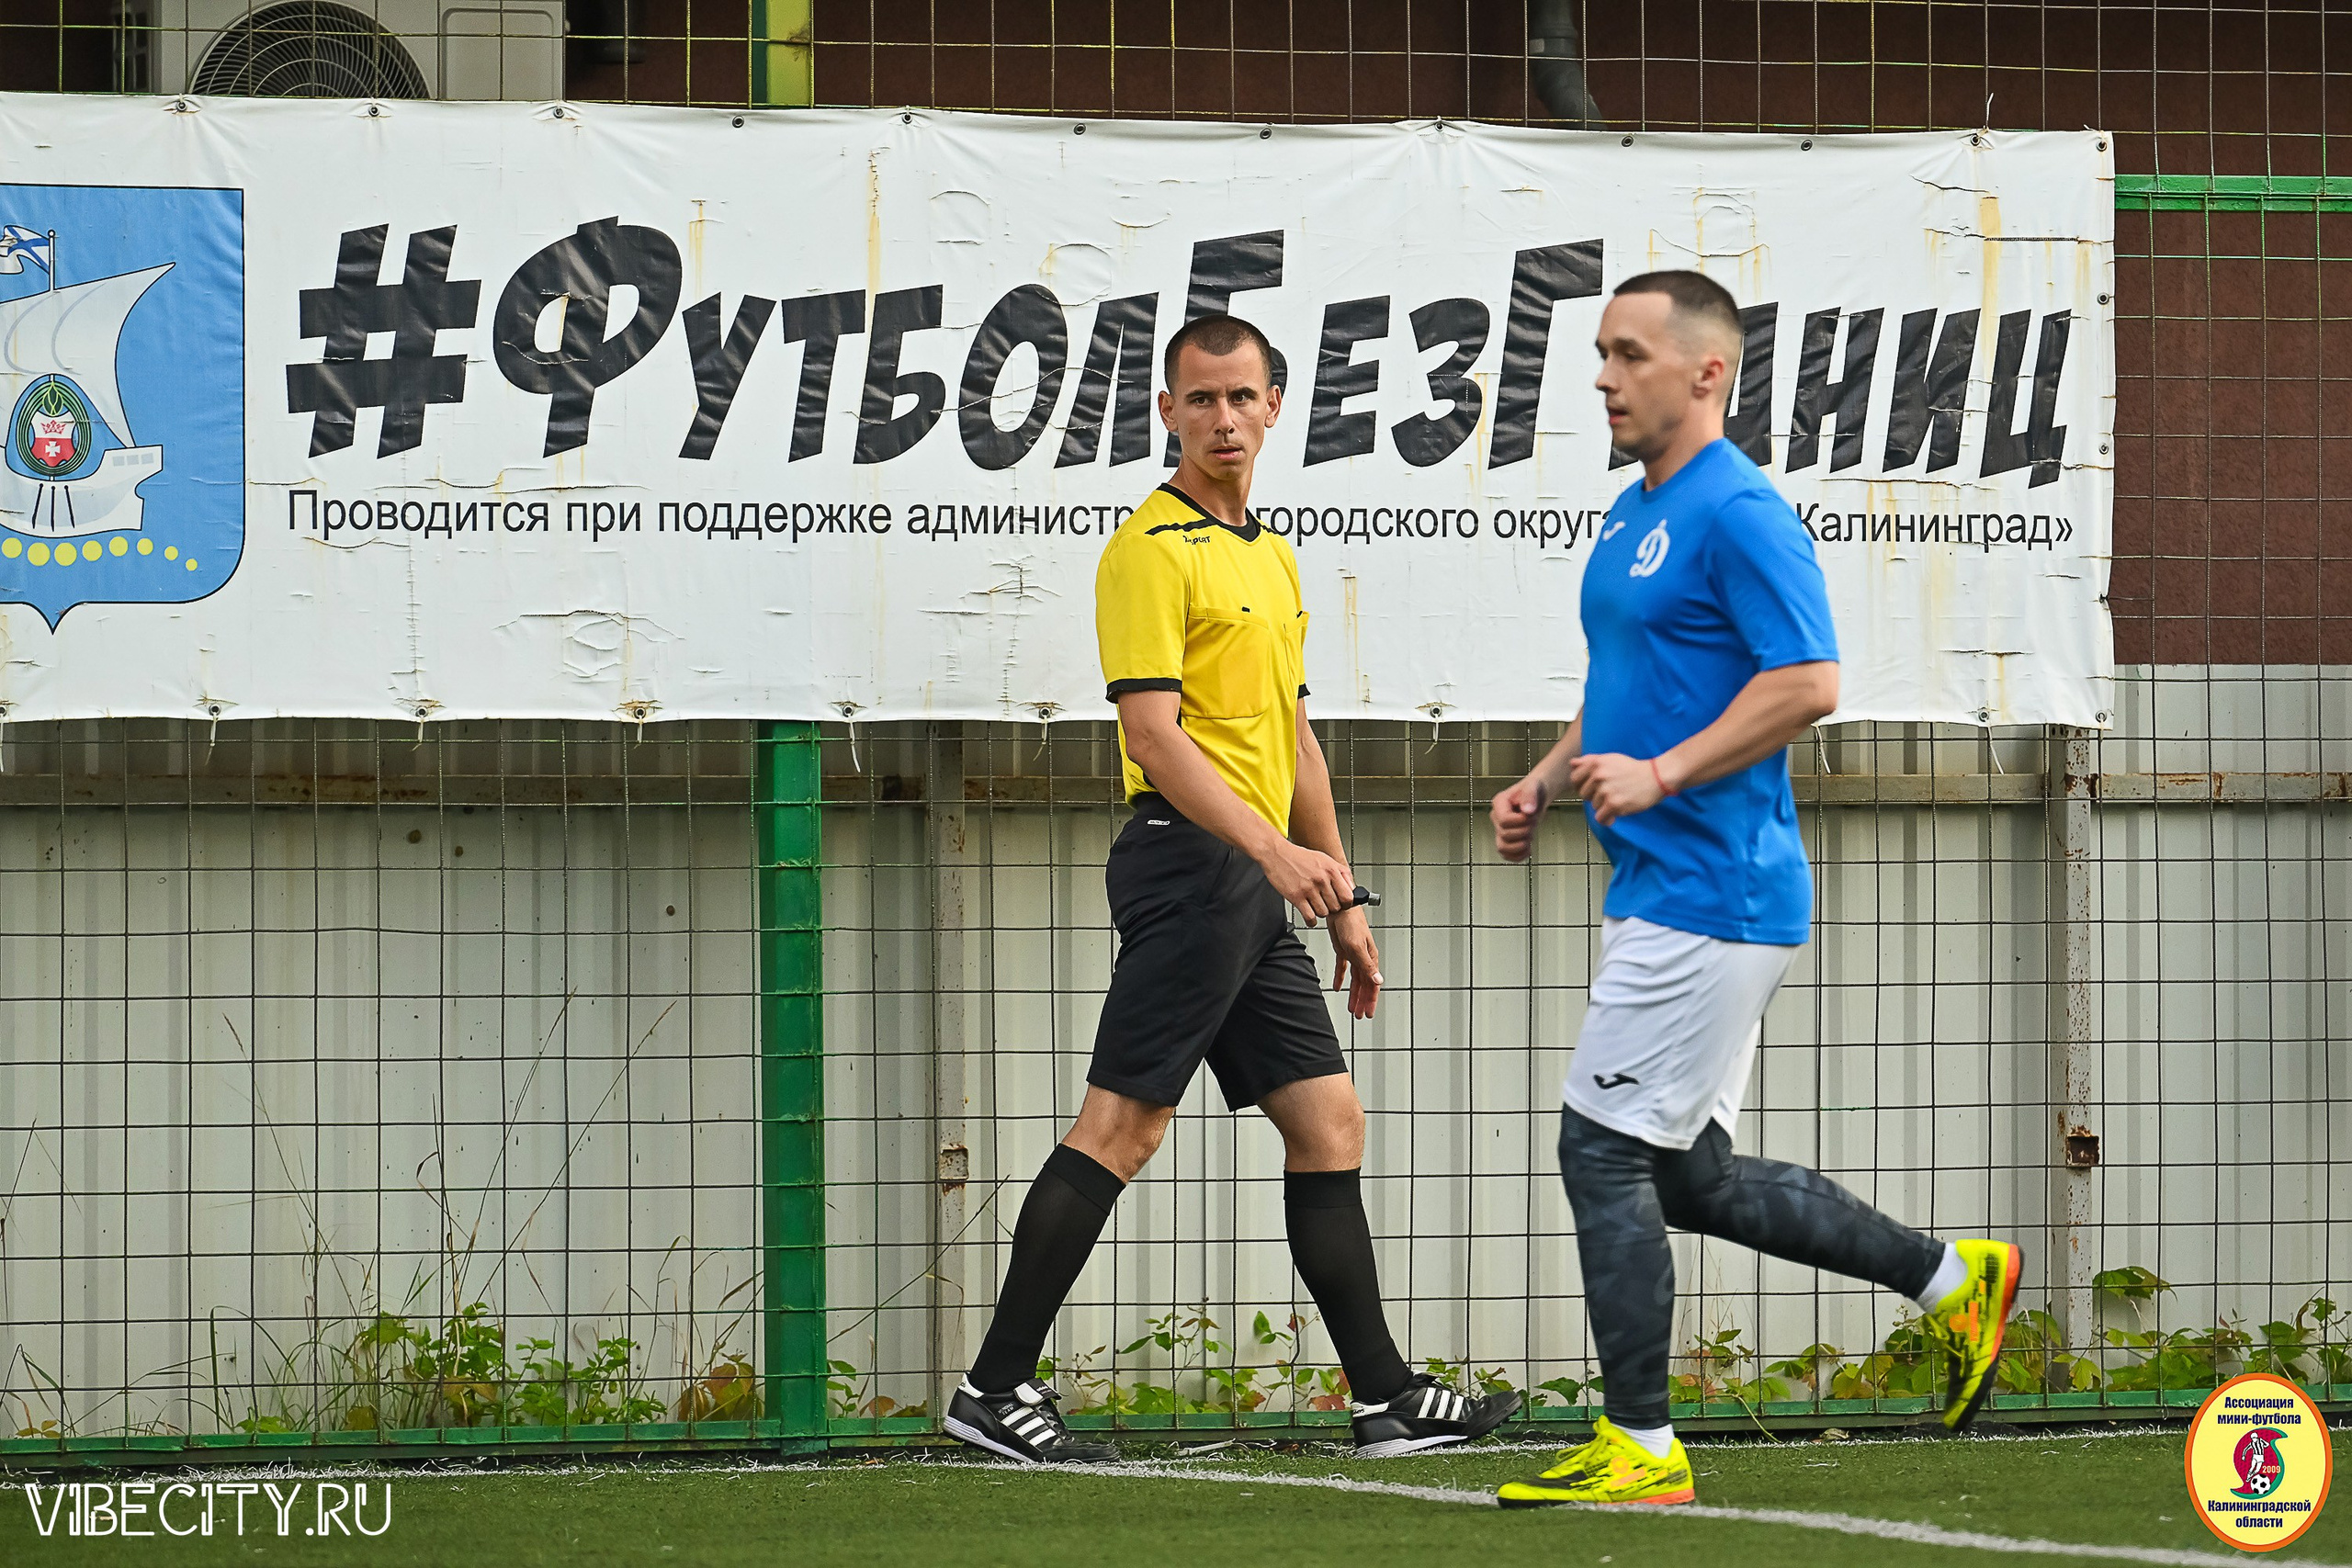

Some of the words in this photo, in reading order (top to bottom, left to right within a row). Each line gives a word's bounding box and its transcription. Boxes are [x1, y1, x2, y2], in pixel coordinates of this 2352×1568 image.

[289, 490, 548, 540] Проводится
[567, 502, 643, 542] при
[659, 502, 892, 543] поддержке
[907, 503, 1136, 542] админист
[1494, 507, 1612, 549] округ
[1797, 502, 2073, 553] Калининград»
